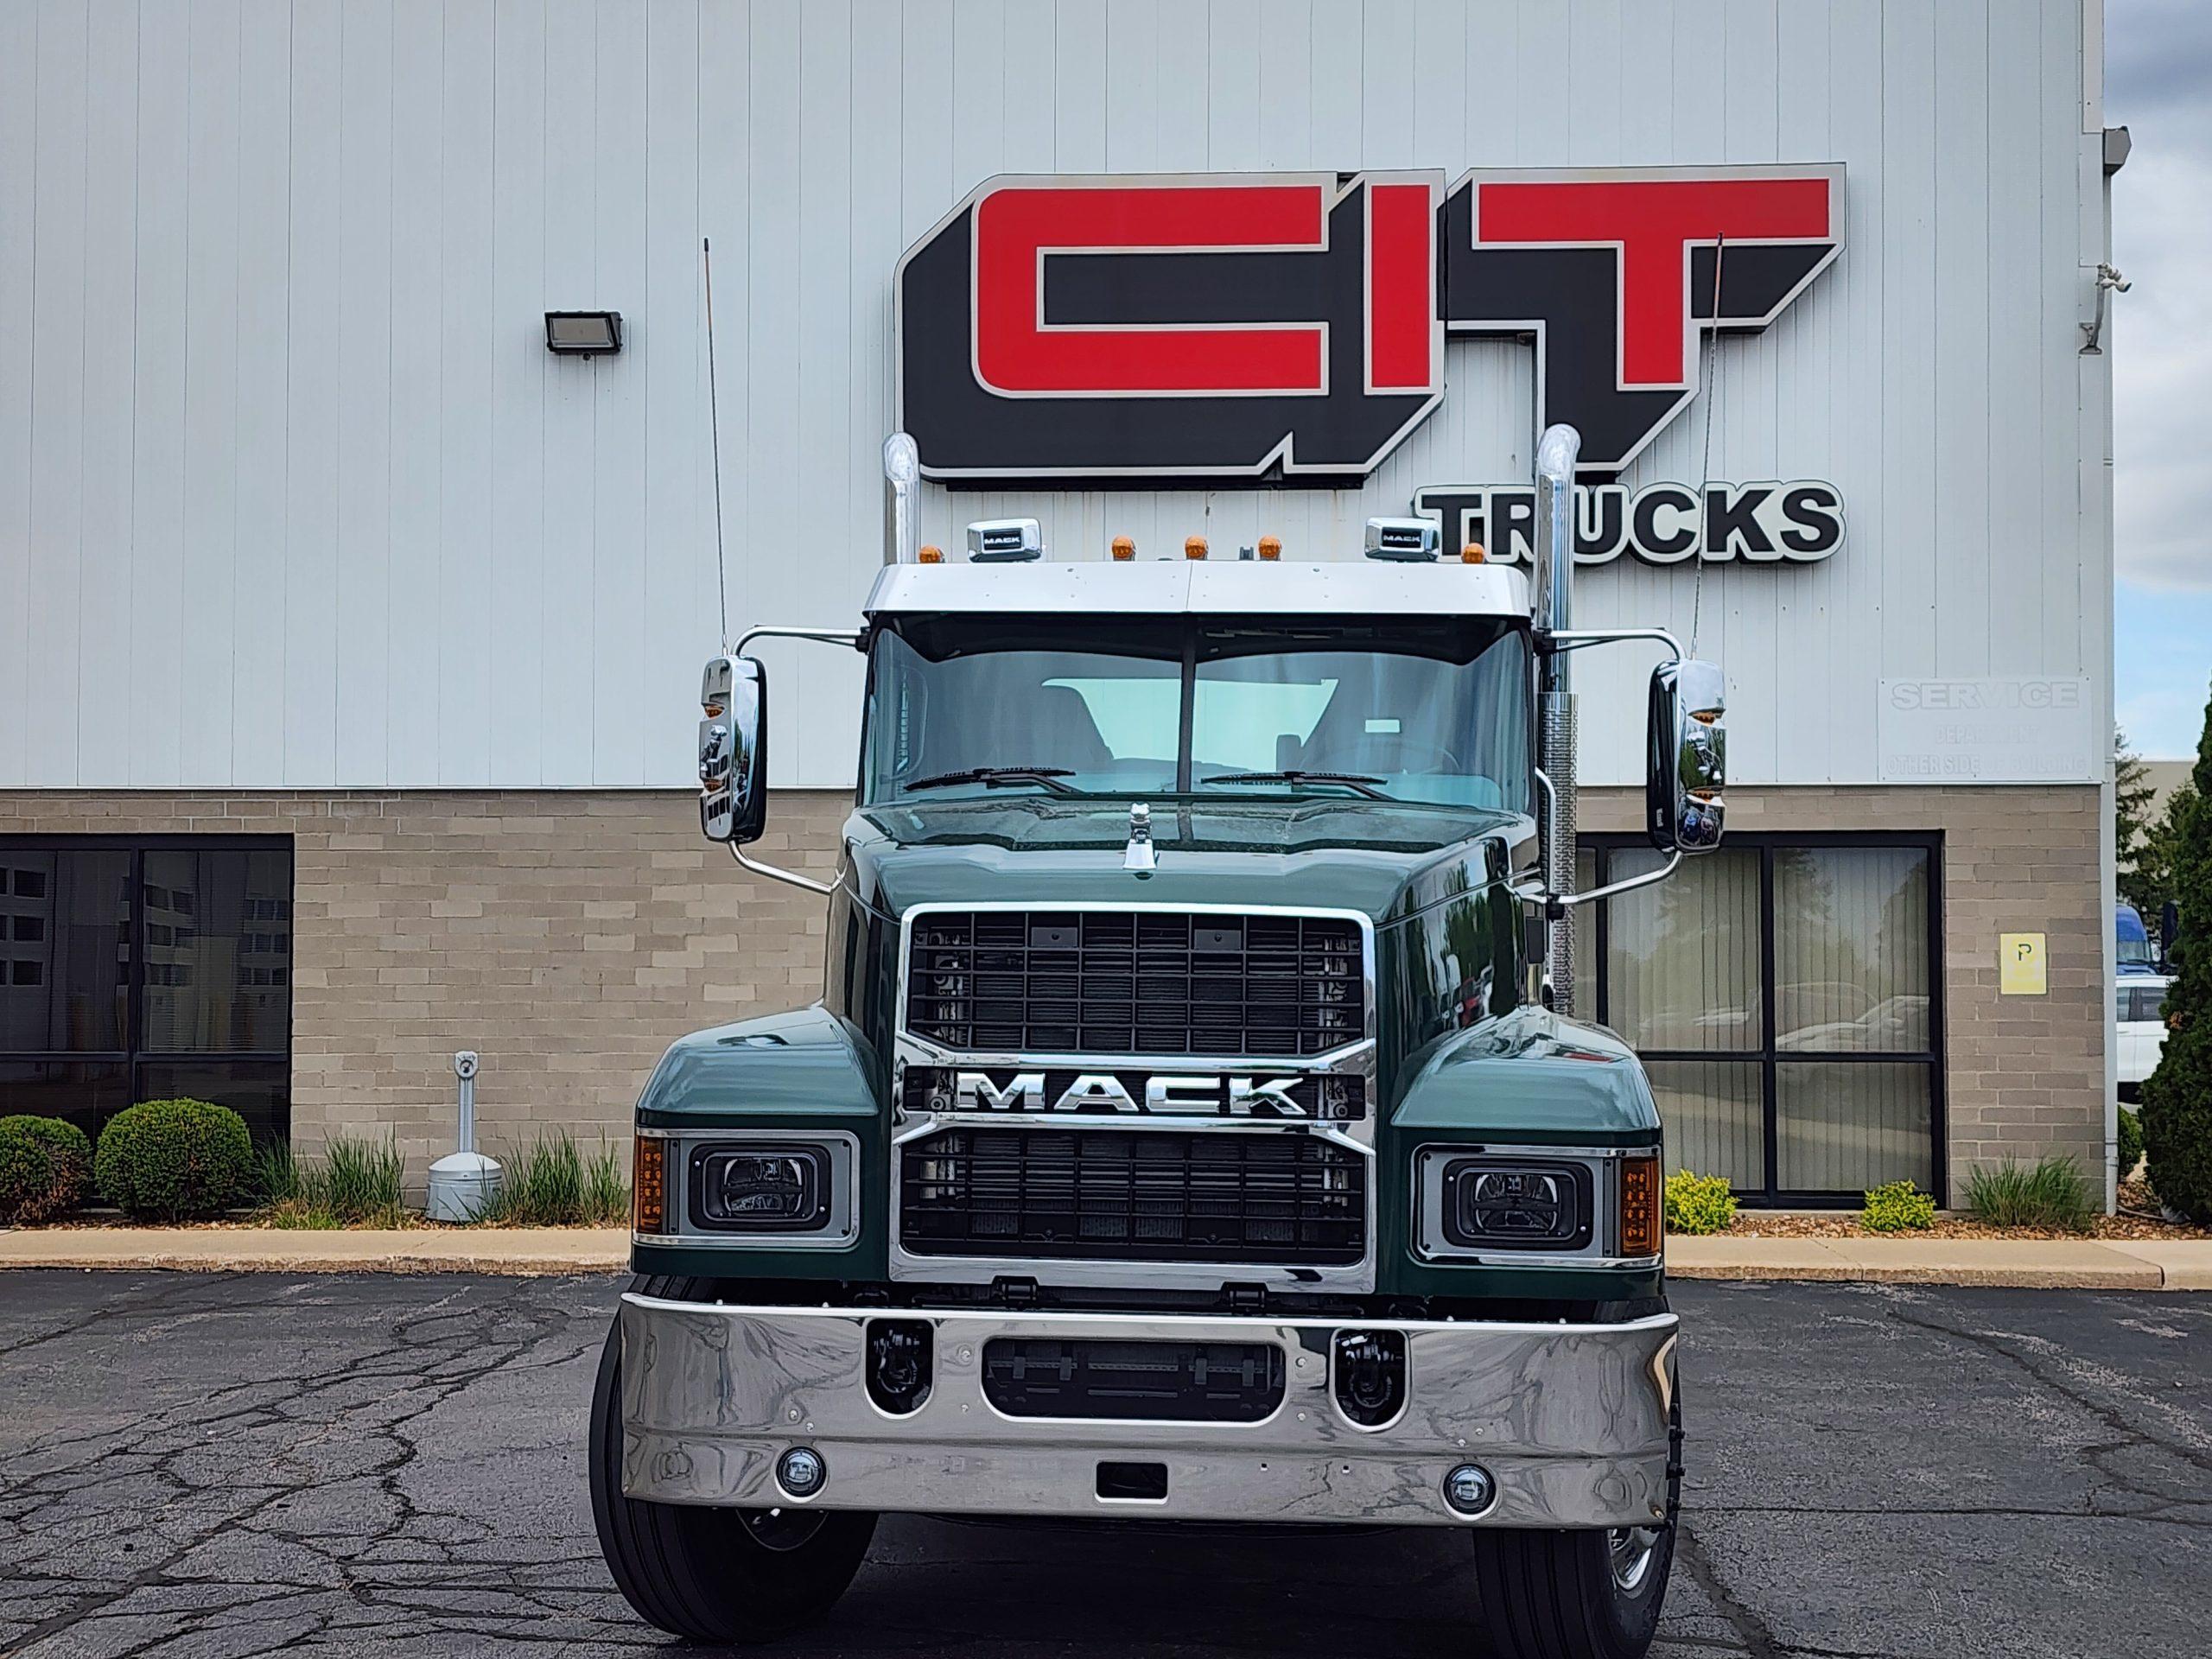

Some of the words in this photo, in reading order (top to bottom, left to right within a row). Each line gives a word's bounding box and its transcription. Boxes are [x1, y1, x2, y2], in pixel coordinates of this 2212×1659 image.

[971, 176, 1835, 396] CIT
[1420, 486, 1841, 556] TRUCKS
[1891, 681, 2079, 709] SERVICE
[1886, 754, 1941, 774] OTHER
[1943, 754, 1980, 774] SIDE
[956, 1072, 1307, 1116] MACK
